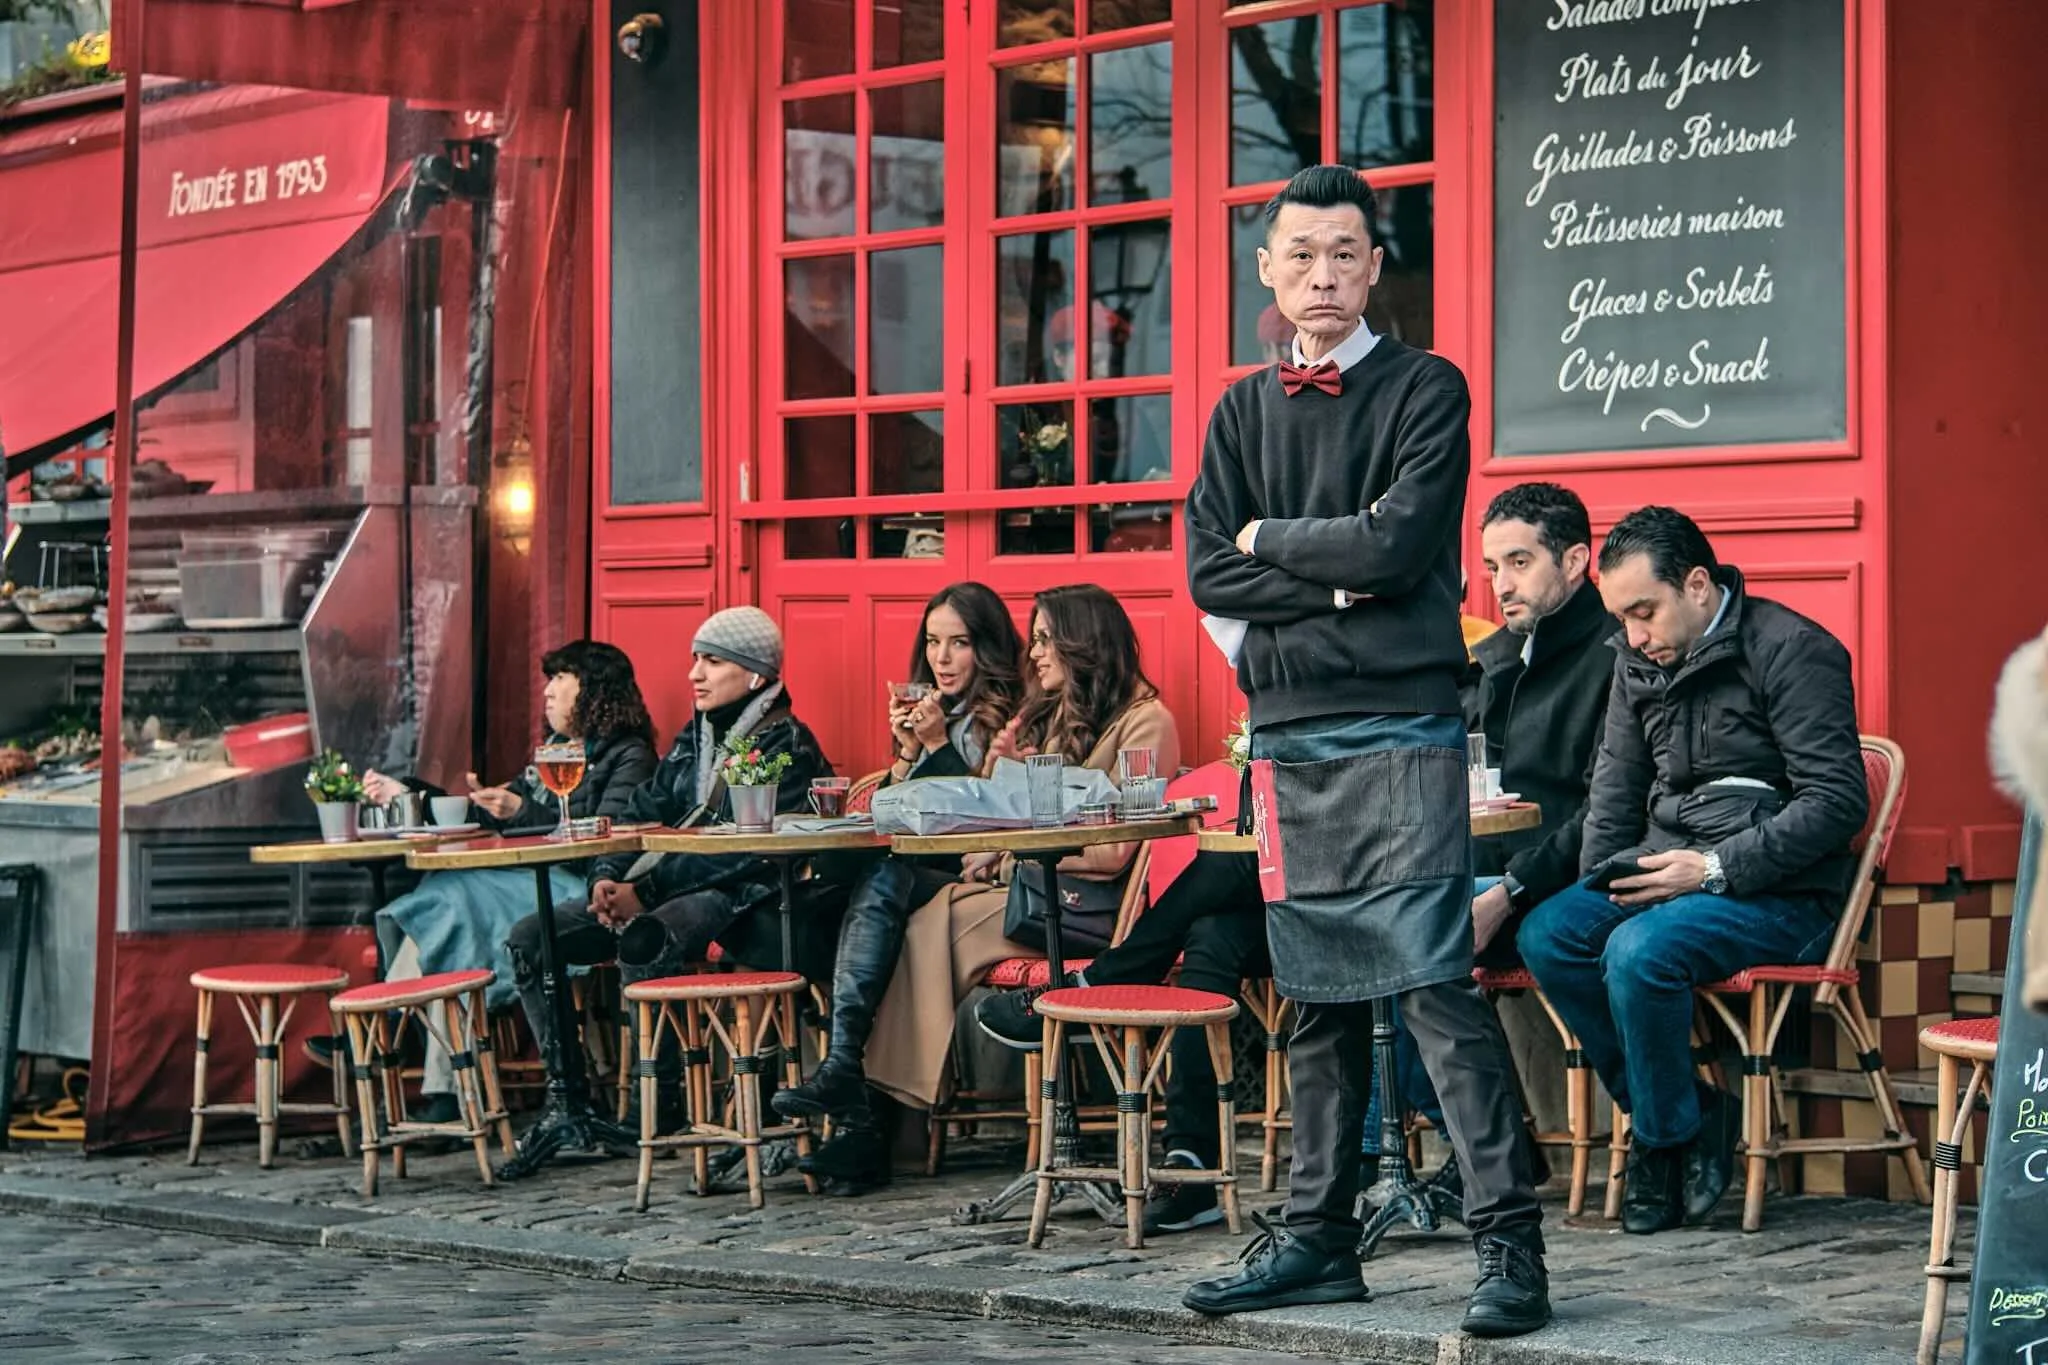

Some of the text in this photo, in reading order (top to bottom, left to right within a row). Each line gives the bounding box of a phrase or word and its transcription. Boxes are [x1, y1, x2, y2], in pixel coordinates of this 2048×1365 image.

[1554, 35, 1762, 110] Plats du jour
[243, 166, 268, 205] EN
[276, 155, 328, 199] 1793
[1526, 131, 1654, 207] Grillades
[1679, 112, 1797, 160] Poissons
[1544, 196, 1784, 249] Patisseries maison
[1560, 264, 1774, 344] Glaces & Sorbets
[1558, 336, 1770, 415] Crêpes & Snack
